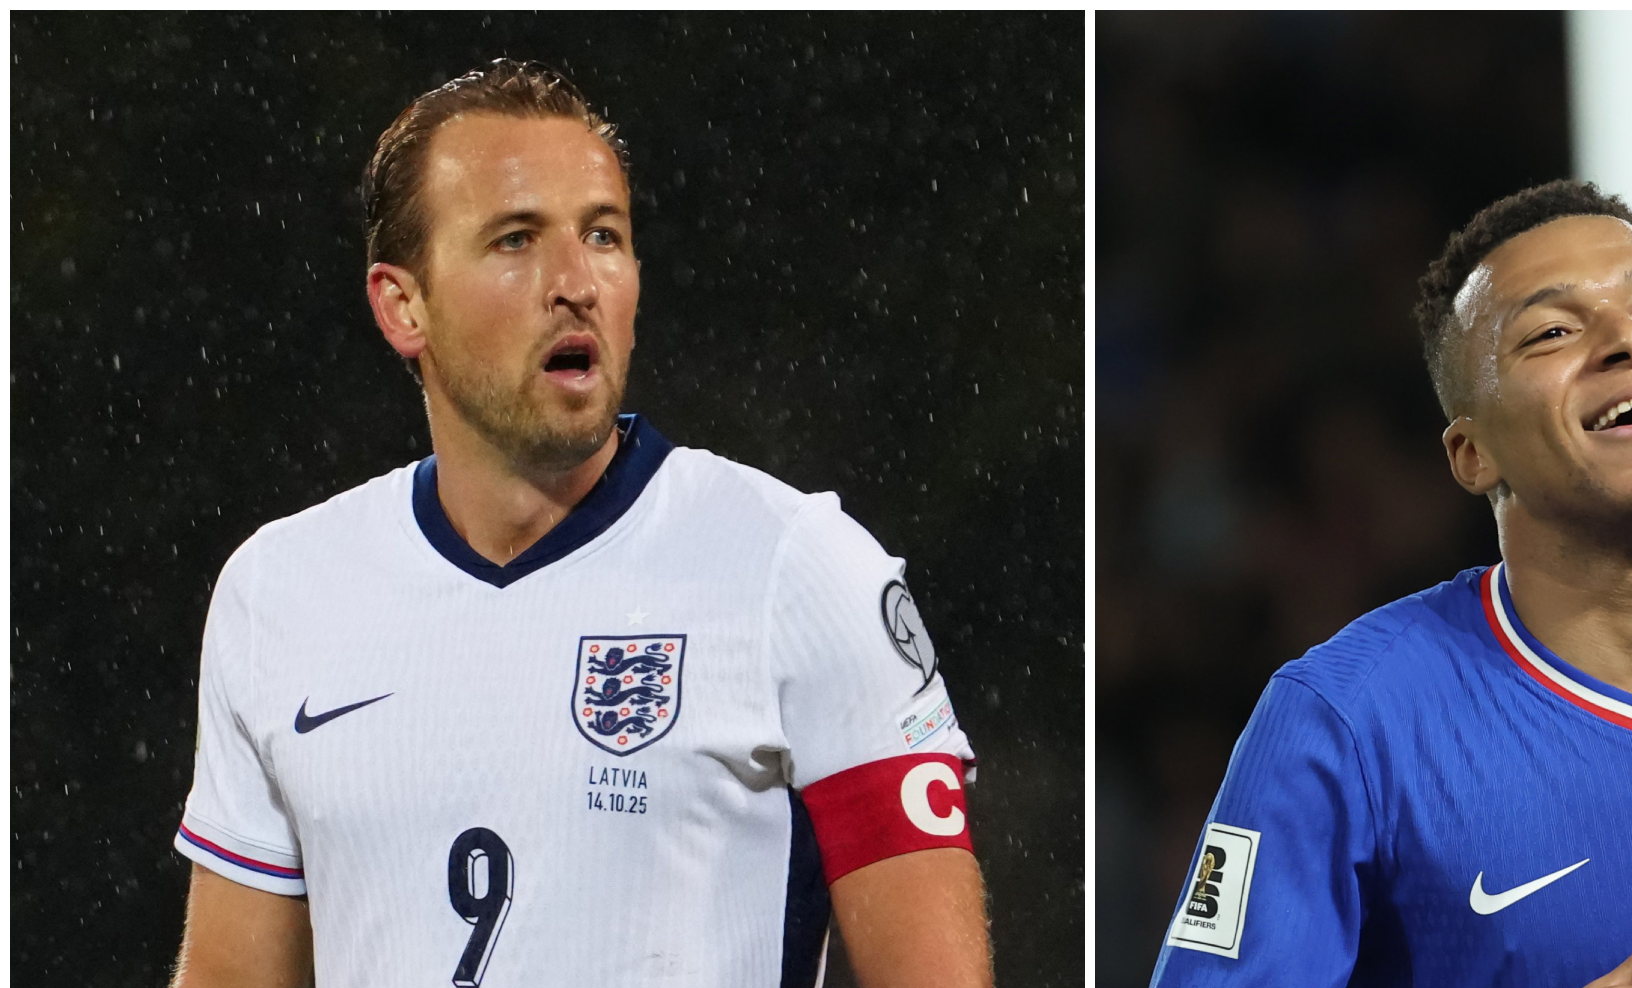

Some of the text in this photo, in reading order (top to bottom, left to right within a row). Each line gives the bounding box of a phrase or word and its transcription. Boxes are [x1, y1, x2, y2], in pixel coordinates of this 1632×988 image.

[589, 766, 647, 789] LATVIA
[587, 791, 647, 814] 14.10.25
[901, 762, 965, 836] C
[448, 827, 514, 988] 9
[1189, 901, 1208, 912] FIFA
[1181, 917, 1216, 930] ALIFIERS
